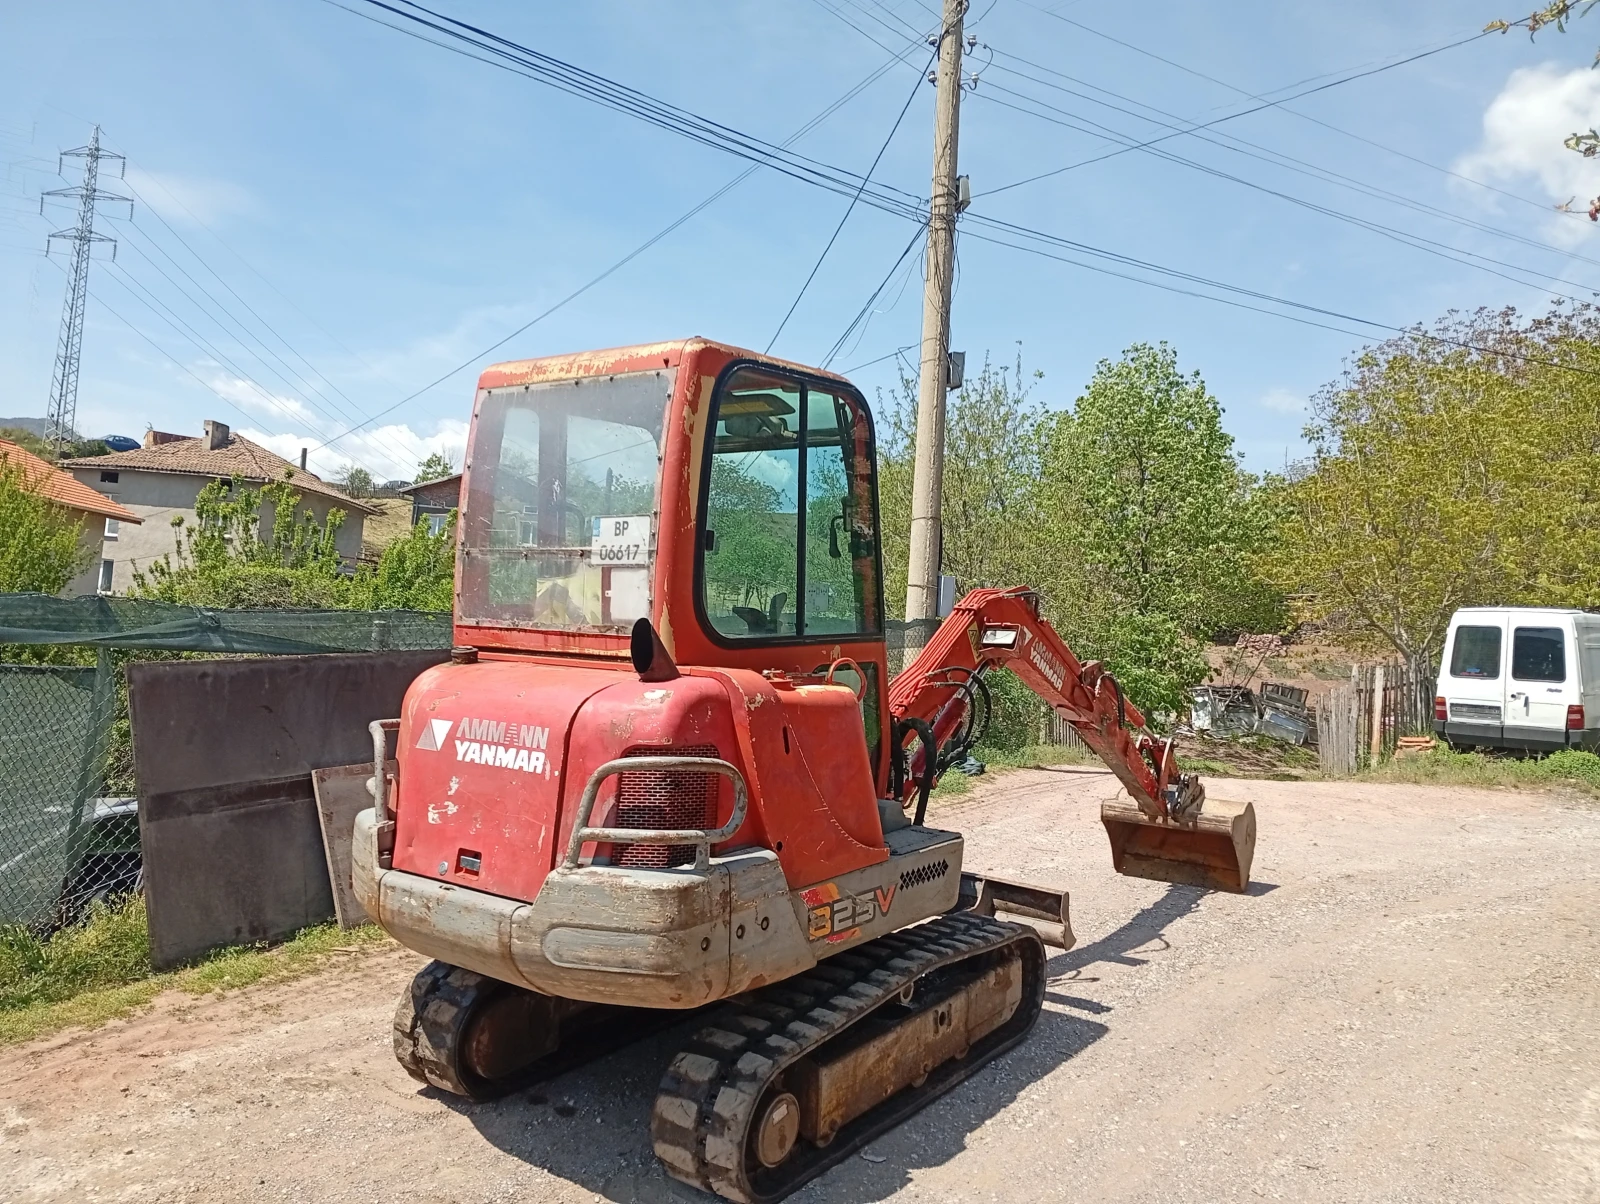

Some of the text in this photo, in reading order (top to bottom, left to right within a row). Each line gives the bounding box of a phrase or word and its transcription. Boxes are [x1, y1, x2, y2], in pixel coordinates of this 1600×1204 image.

[614, 521, 629, 536] BP
[600, 544, 640, 561] 06617
[1030, 646, 1063, 692] YANMAR
[456, 717, 549, 749] AMMANN
[455, 740, 546, 774] YANMAR
